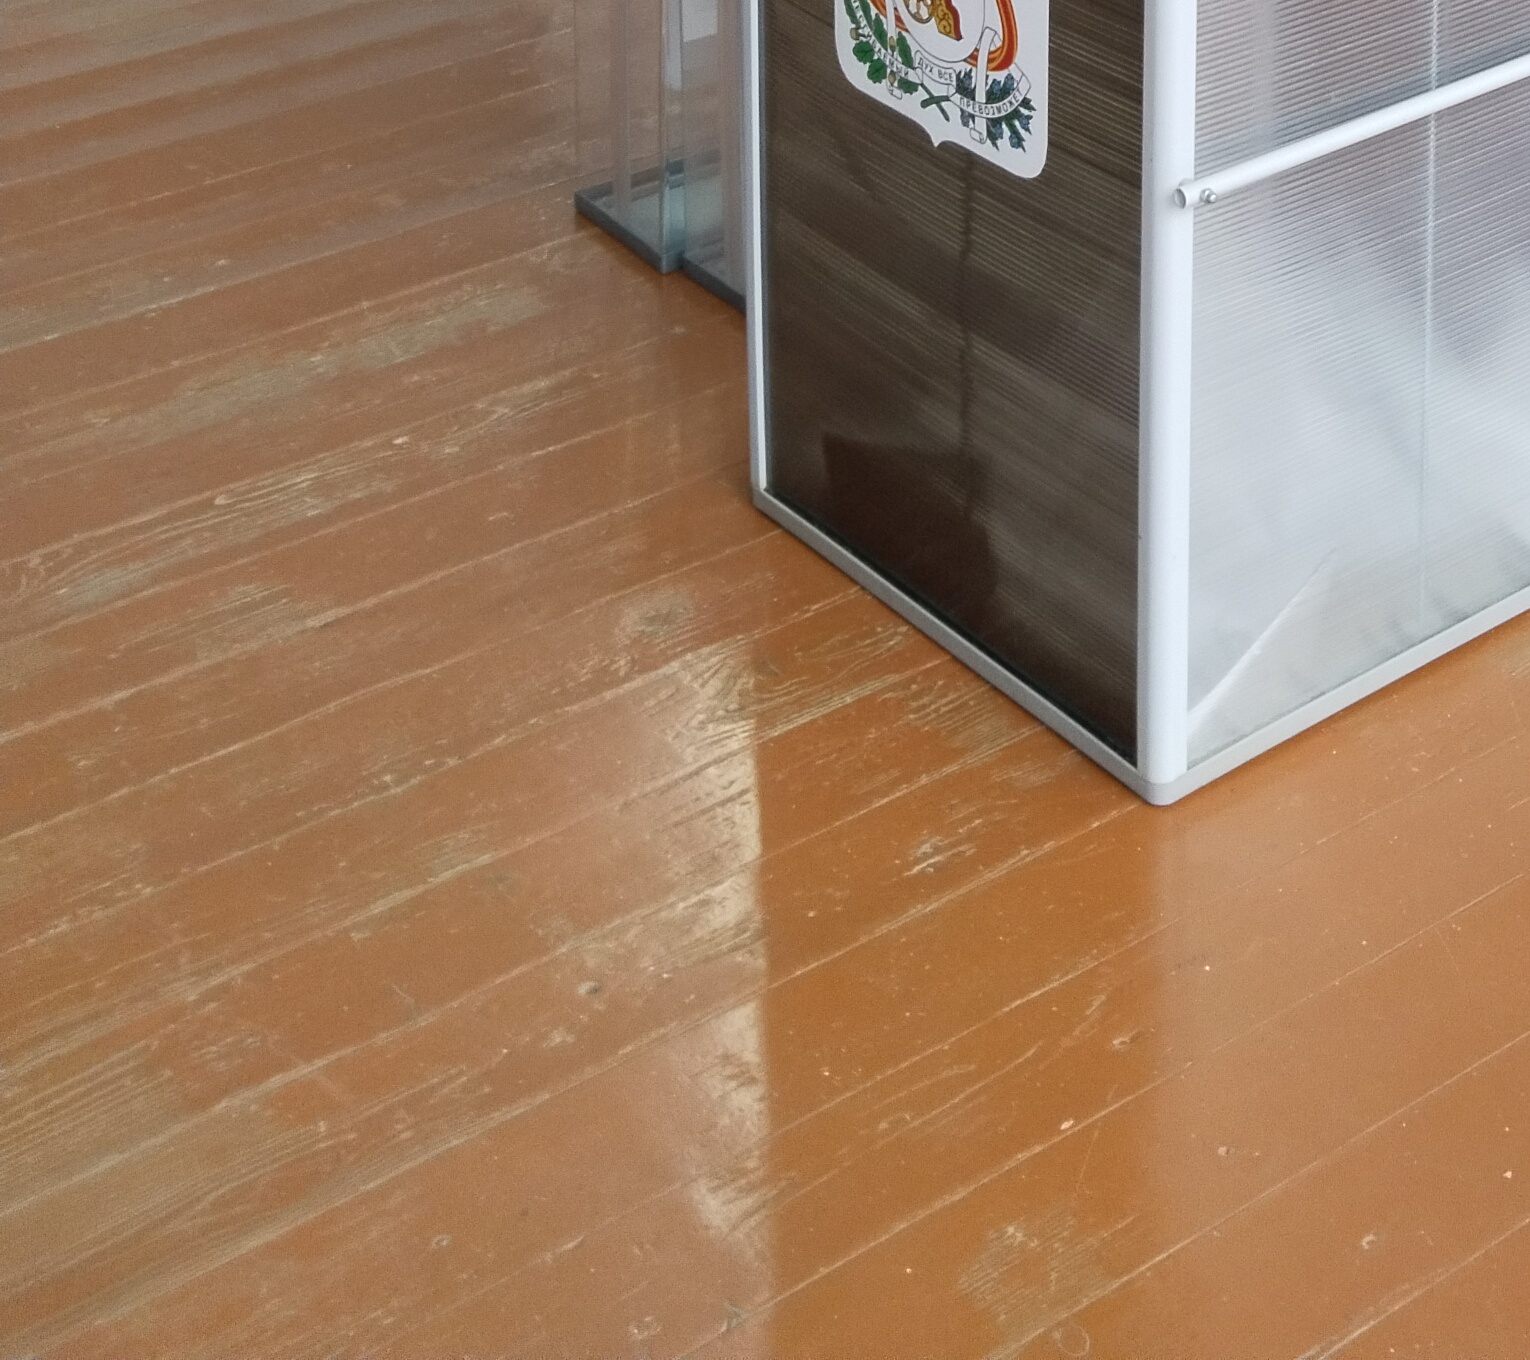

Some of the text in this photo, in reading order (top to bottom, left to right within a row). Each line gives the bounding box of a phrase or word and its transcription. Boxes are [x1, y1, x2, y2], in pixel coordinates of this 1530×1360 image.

[918, 58, 934, 74] ДУХ
[938, 68, 954, 83] ВСЕ
[960, 87, 1023, 116] ПРЕВОЗМОЖЕТ
